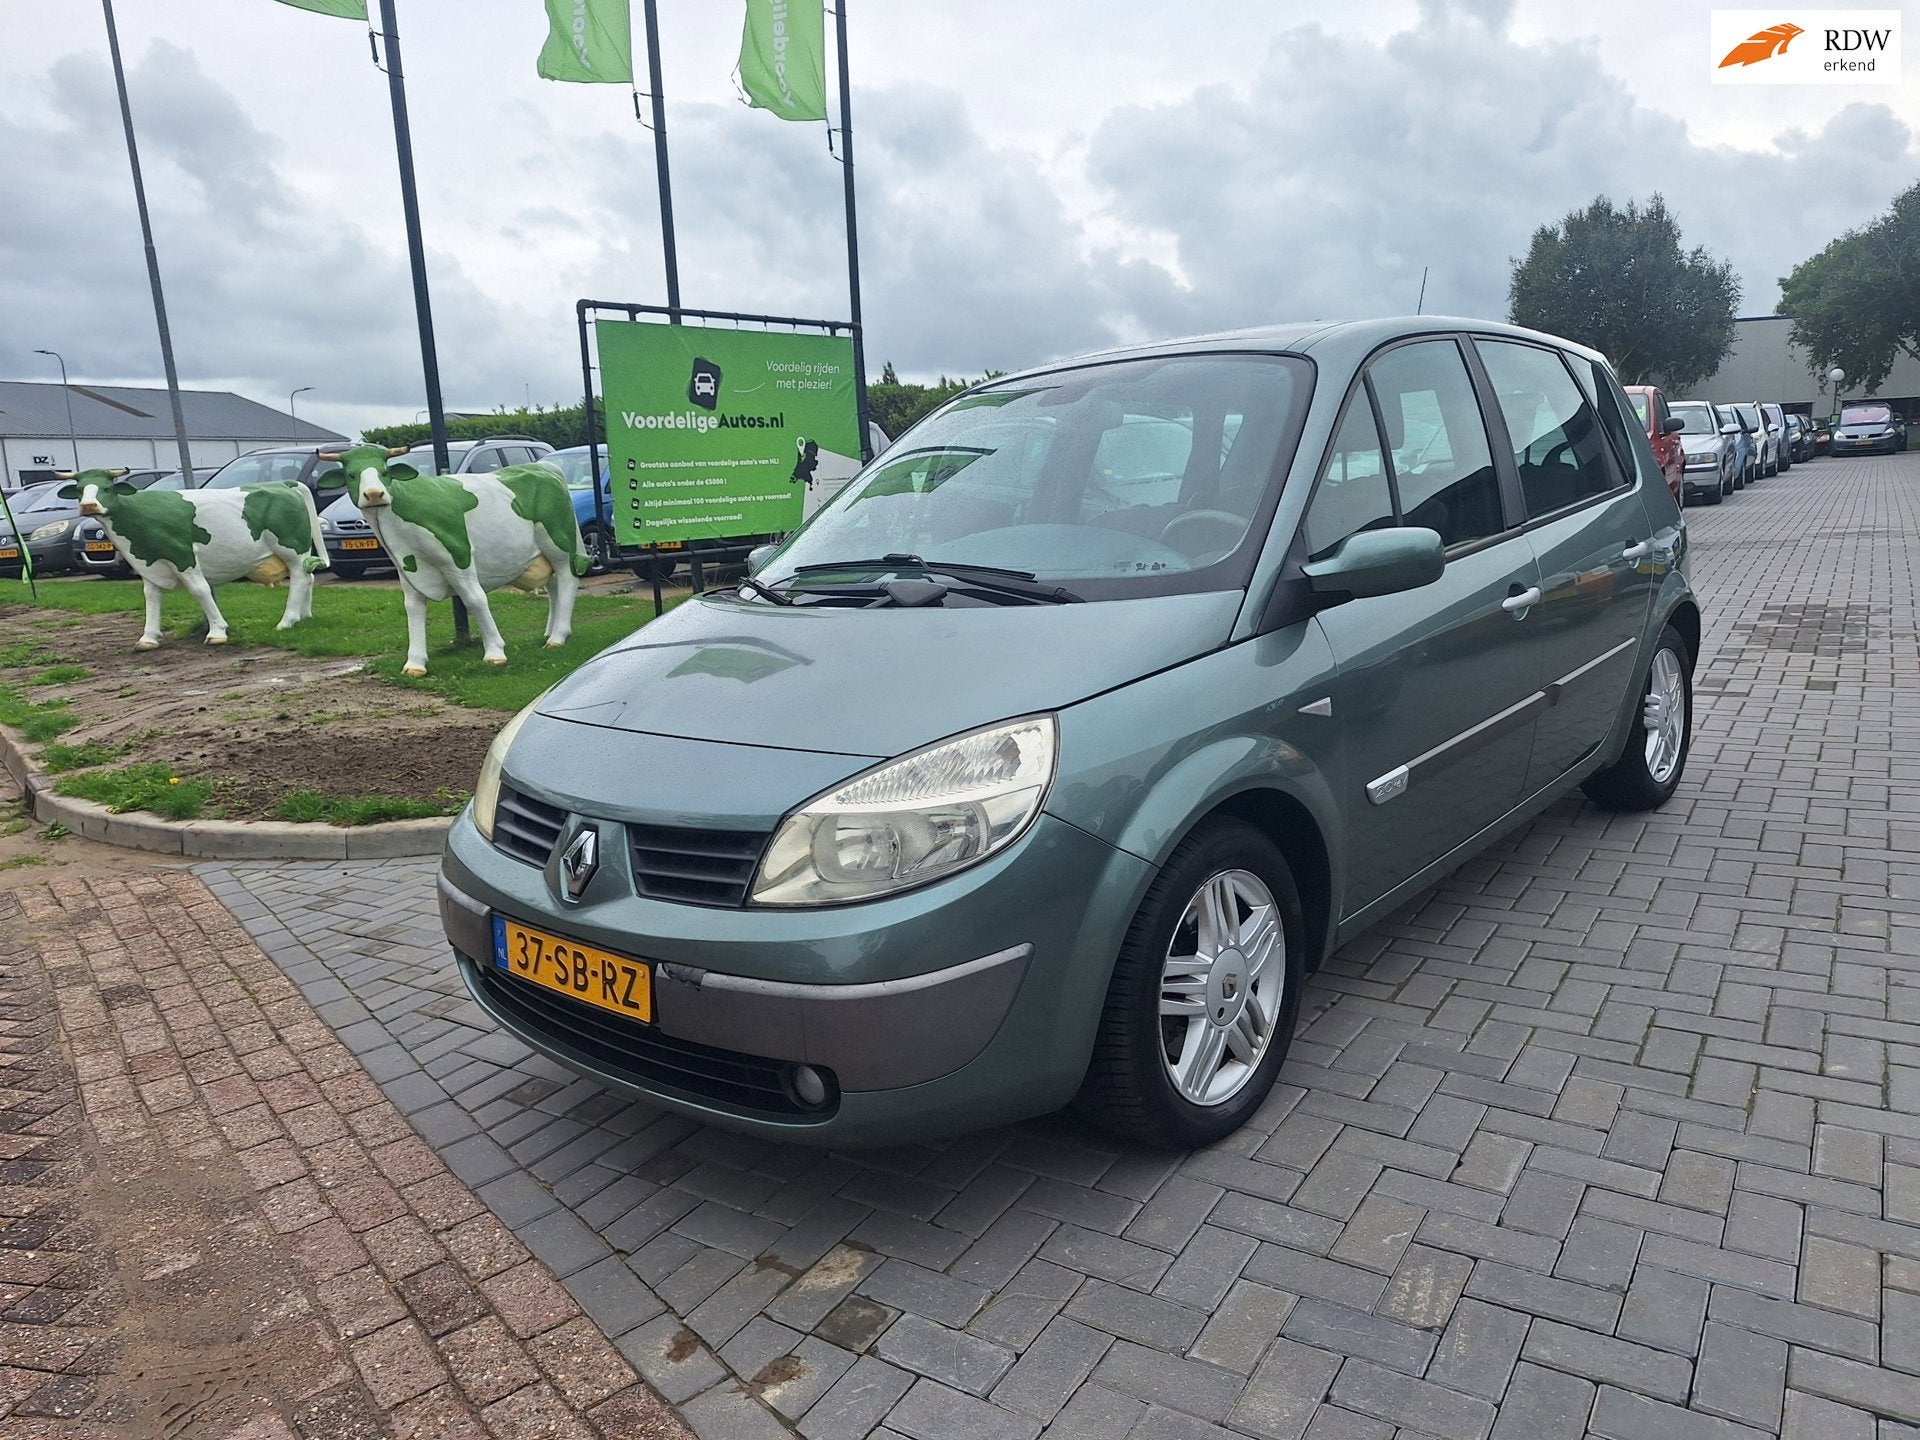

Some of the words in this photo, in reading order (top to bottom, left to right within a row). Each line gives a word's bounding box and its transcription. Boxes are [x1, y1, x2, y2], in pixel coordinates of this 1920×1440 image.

[573, 0, 593, 69] Voor
[766, 360, 812, 376] Voordelig
[813, 362, 840, 376] rijden
[776, 379, 796, 389] met
[797, 378, 832, 392] plezier!
[621, 411, 784, 434] VoordeligeAutos.nl
[640, 461, 669, 469] Grootste
[670, 460, 694, 468] aanbod
[707, 459, 739, 467] voordelige
[740, 458, 758, 466] auto's
[642, 480, 655, 488] Alle
[676, 479, 695, 487] onder
[644, 500, 662, 508] Altijd
[663, 498, 693, 506] minimaal
[705, 496, 737, 504] voordelige
[738, 494, 756, 502] auto's
[765, 492, 791, 500] voorraad!
[645, 518, 677, 527] Dagelijks
[677, 515, 713, 524] wisselende
[714, 513, 743, 521] voorraad!
[517, 931, 640, 1010] 37-SB-RZ
